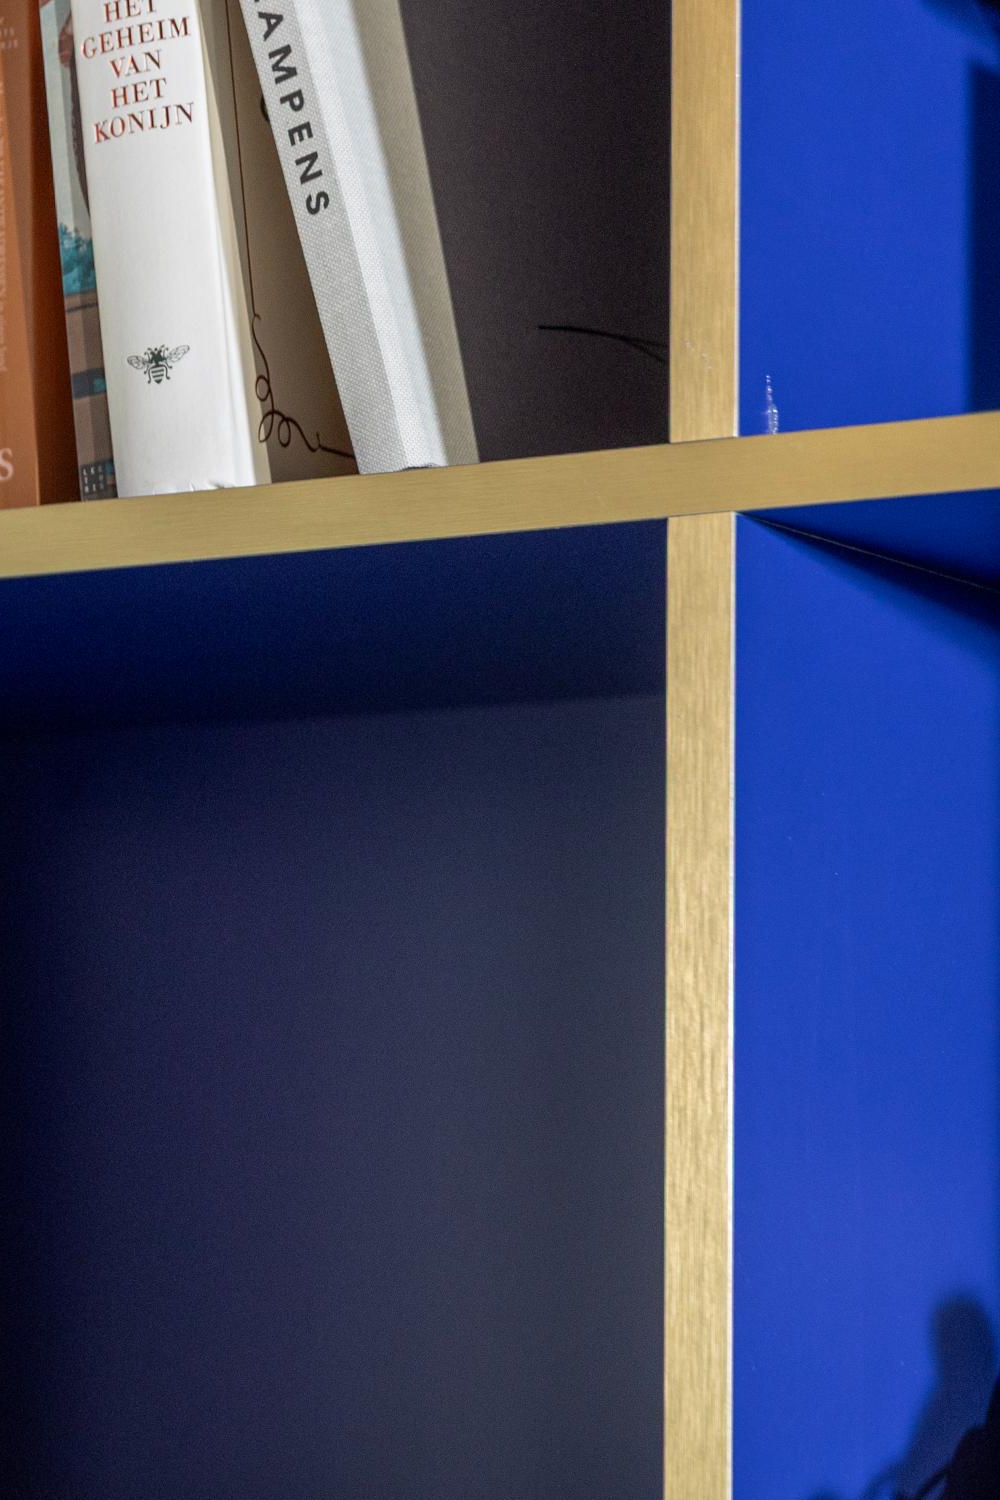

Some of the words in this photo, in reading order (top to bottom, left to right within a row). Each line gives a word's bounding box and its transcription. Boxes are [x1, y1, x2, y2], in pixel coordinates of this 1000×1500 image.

[104, 0, 157, 24] HET
[80, 16, 191, 59] GEHEIM
[109, 48, 162, 79] VAN
[110, 77, 167, 109] HET
[254, 0, 330, 216] AMPENS
[93, 102, 195, 145] KONIJN
